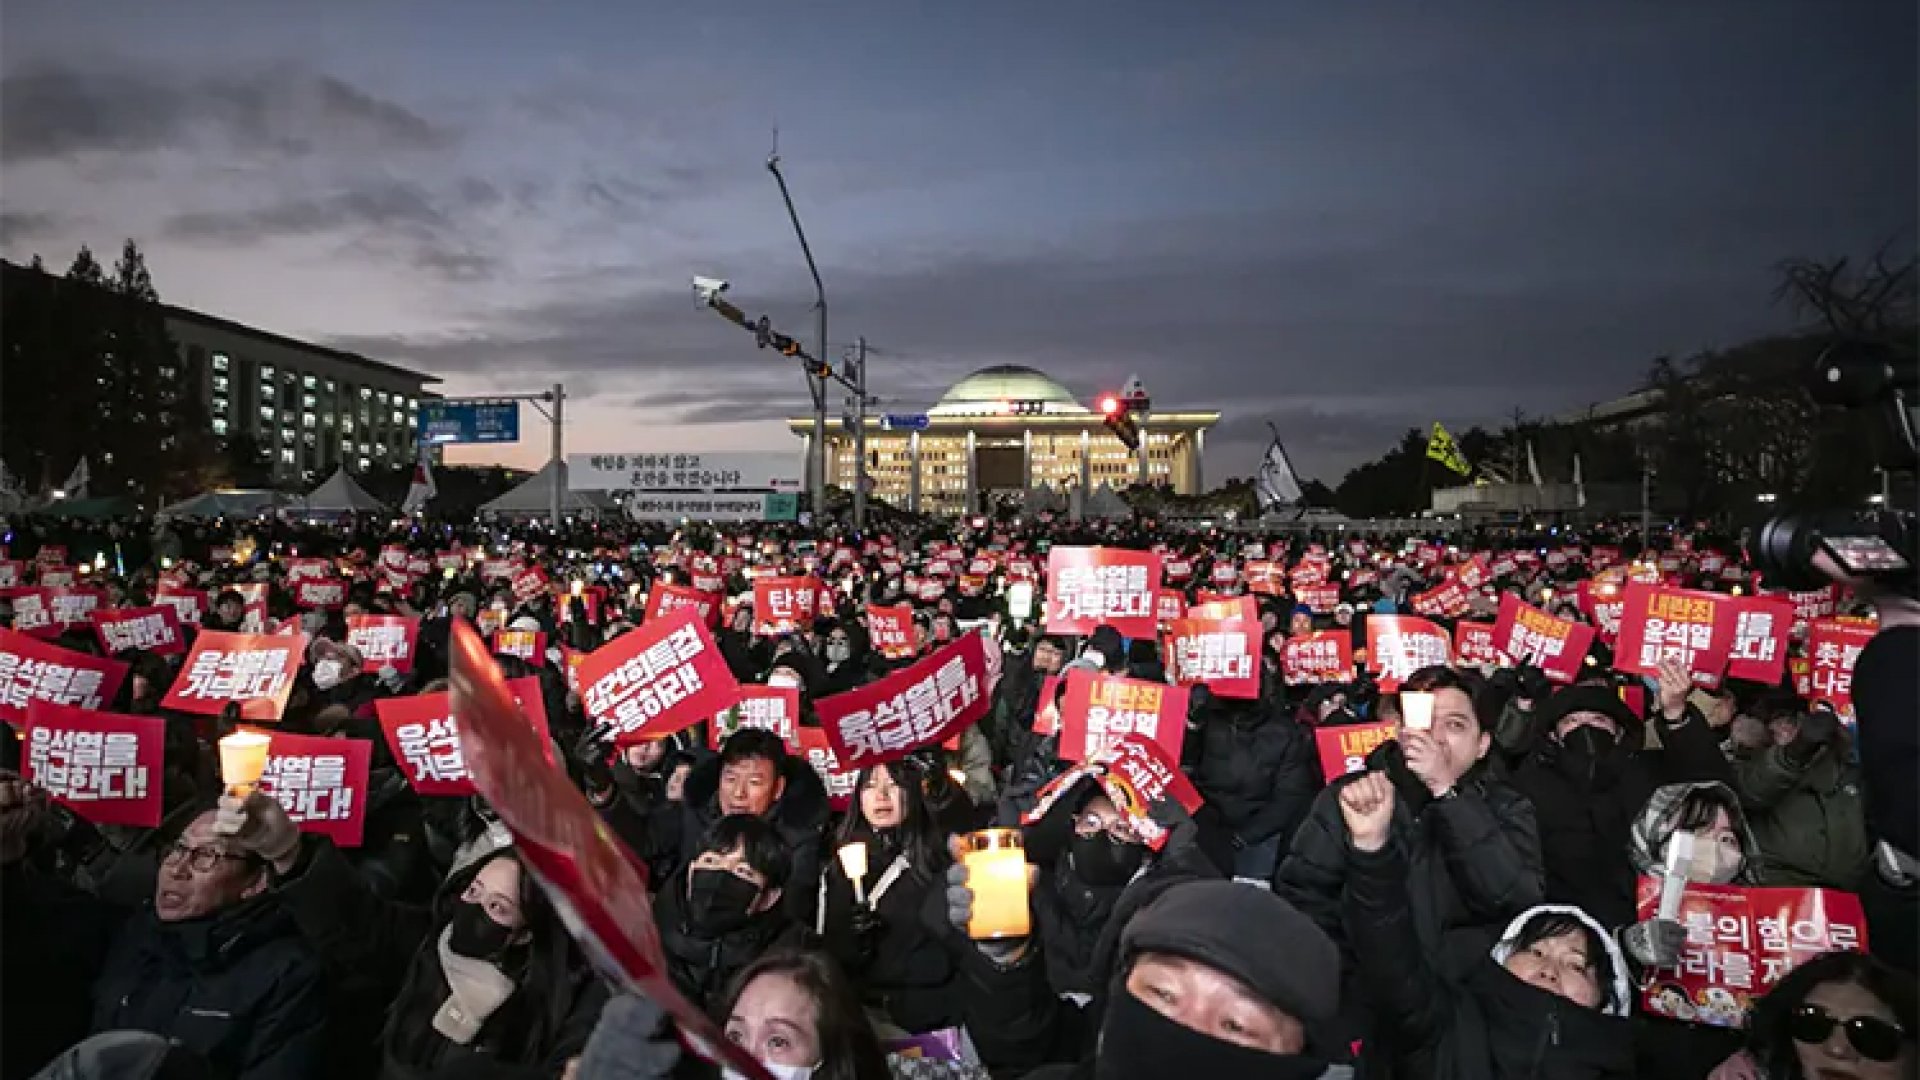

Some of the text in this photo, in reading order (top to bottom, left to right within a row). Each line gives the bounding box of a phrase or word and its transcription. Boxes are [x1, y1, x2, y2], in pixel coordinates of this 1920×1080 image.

[1057, 565, 1148, 592] 윤석열을
[1057, 590, 1153, 620] 거부한다!
[1516, 605, 1573, 639] 내란죄
[1648, 593, 1716, 623] 내란죄
[1511, 623, 1565, 656] 윤석열
[1644, 618, 1711, 650] 윤석열
[191, 649, 291, 680] 윤석열을
[586, 622, 705, 716] 김건희특검
[178, 673, 288, 700] 거부한다!
[837, 654, 968, 740] 윤석열을
[1089, 679, 1163, 713] 내란죄
[848, 674, 981, 762] 거부한다!
[1087, 707, 1158, 739] 윤석열
[30, 726, 139, 768] 윤석열을
[397, 714, 459, 757] 윤석
[32, 760, 148, 800] 거부한다!
[264, 754, 344, 789] 석열을
[277, 787, 353, 821] 한다!
[1684, 910, 1750, 950] 불의
[1676, 949, 1755, 989] 라를
